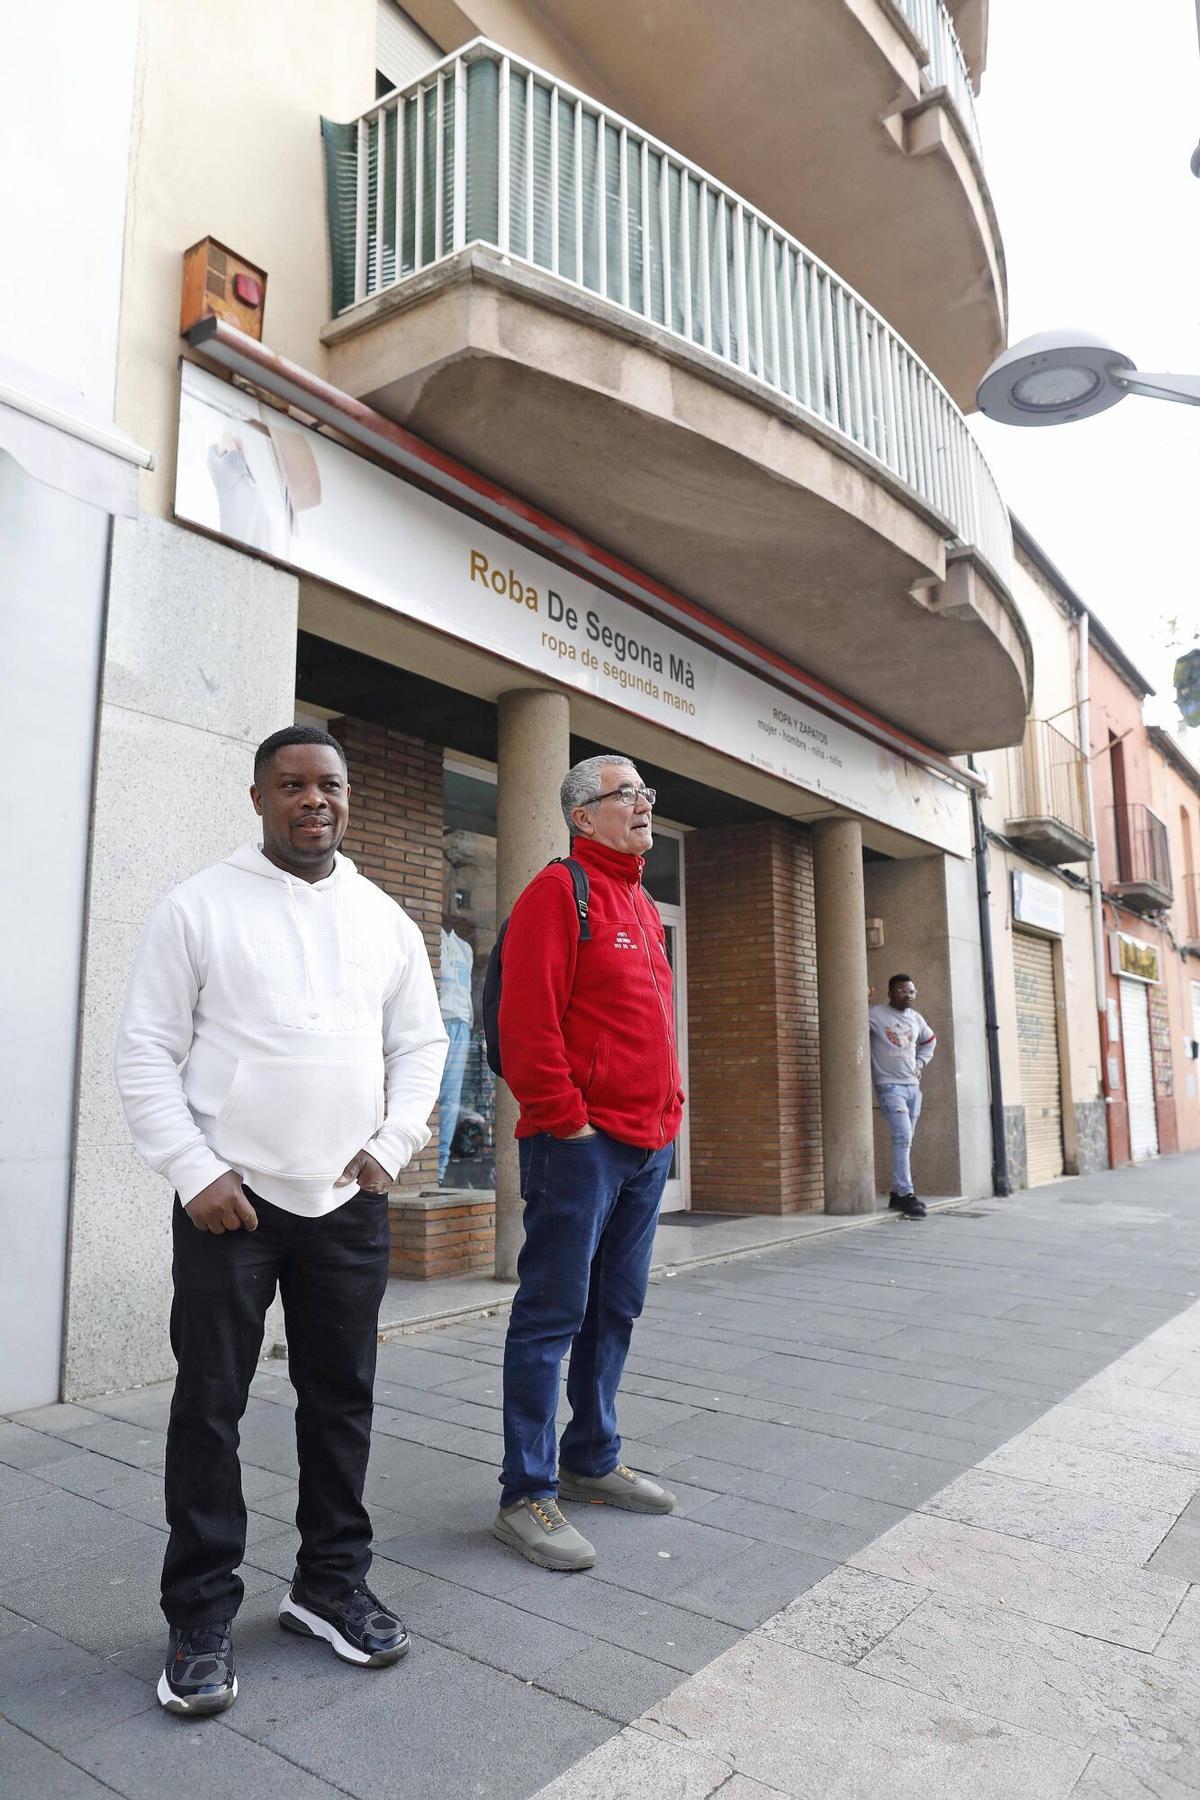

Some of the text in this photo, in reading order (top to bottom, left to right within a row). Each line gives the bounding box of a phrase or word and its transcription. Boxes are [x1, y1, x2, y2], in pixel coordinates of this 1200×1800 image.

[470, 550, 695, 690] Roba De Segona Mà
[541, 631, 696, 716] ropa de segunda mano
[757, 719, 777, 736] mujer
[782, 729, 807, 752] hombre
[773, 707, 829, 746] ROPA Y ZAPATOS
